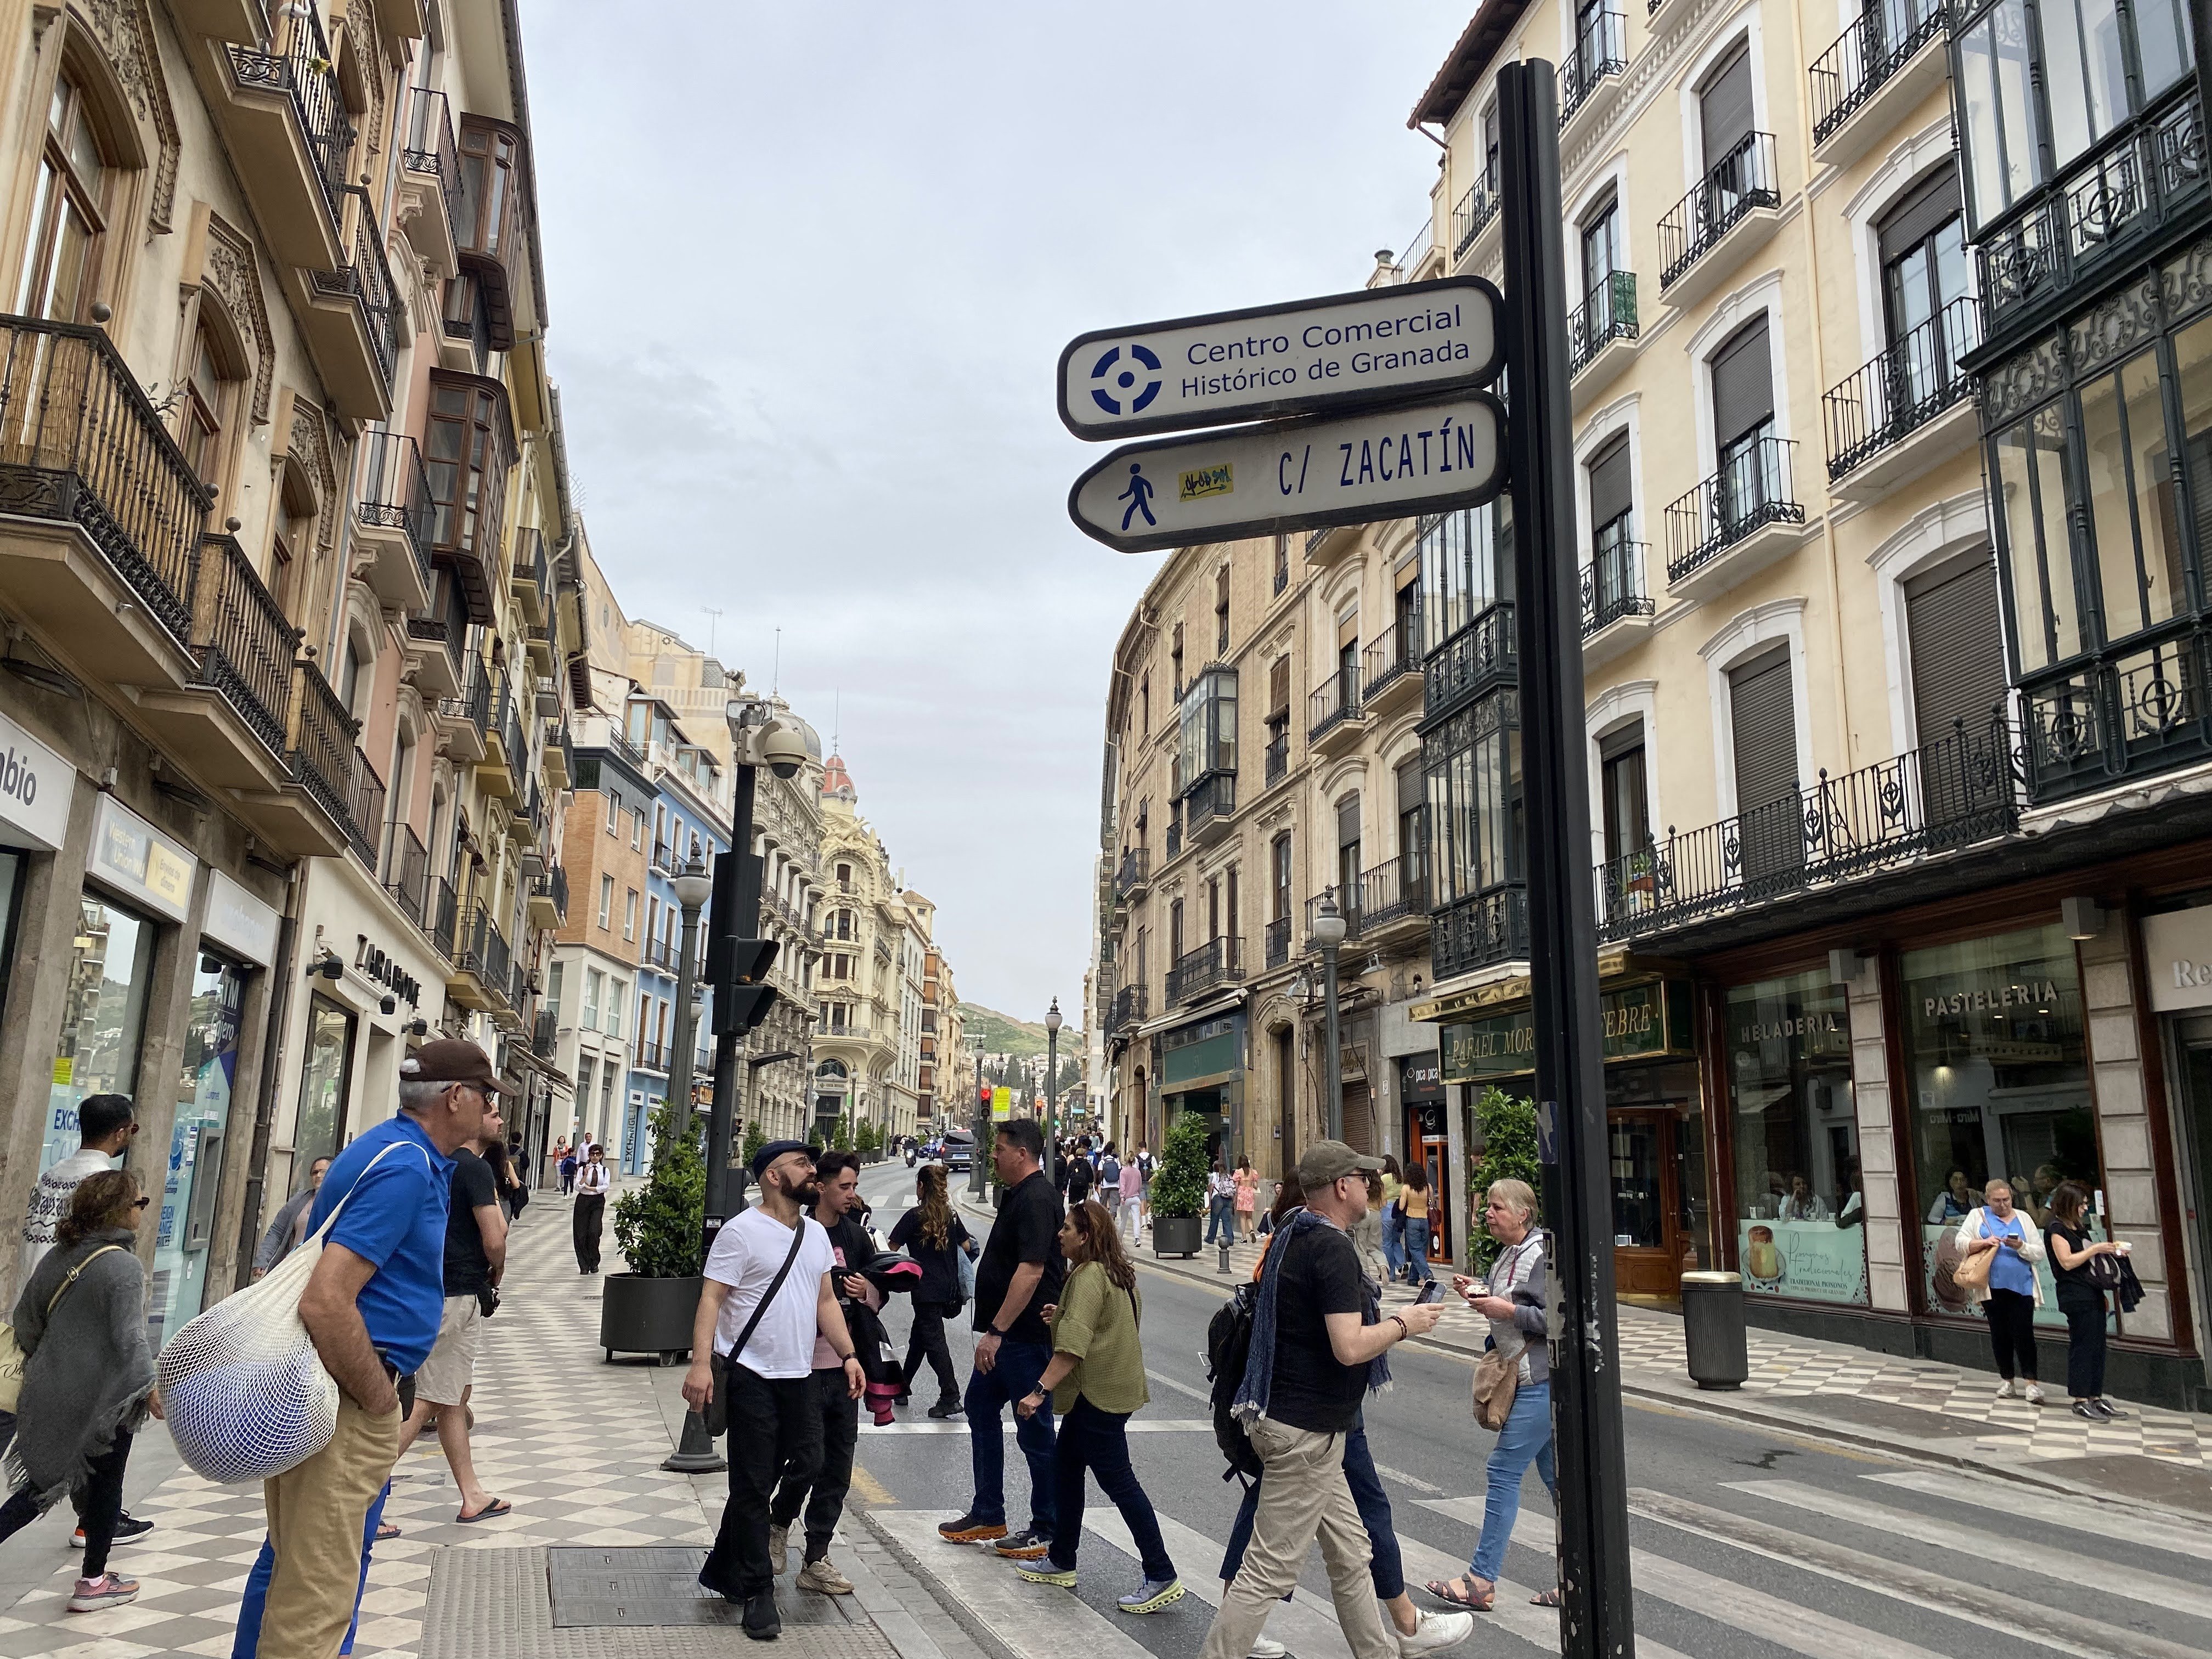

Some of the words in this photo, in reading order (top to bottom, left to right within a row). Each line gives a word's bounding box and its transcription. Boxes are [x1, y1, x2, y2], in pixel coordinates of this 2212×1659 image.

[1188, 336, 1289, 365] Centro
[1302, 304, 1462, 348] Comercial
[1182, 367, 1297, 398] Histórico
[1308, 358, 1340, 380] de
[1351, 340, 1469, 374] Granada
[1279, 444, 1311, 495] C/
[1339, 416, 1475, 487] ZACATÍN
[215, 974, 240, 1009] ATM
[355, 934, 392, 988] ZARA
[391, 964, 422, 1009] HOME
[2172, 960, 2212, 989] Re
[1925, 980, 2058, 1017] PASTELERIA
[1452, 1032, 1497, 1063] RAFAEL
[1503, 1027, 1534, 1055] MOR
[1601, 1004, 1651, 1039] EBRE
[1741, 1013, 1836, 1043] HELADERIA
[54, 1109, 81, 1132] EXCH
[625, 1114, 636, 1162] EXCHANGE
[1790, 1278, 1820, 1287] TRADITIONAL
